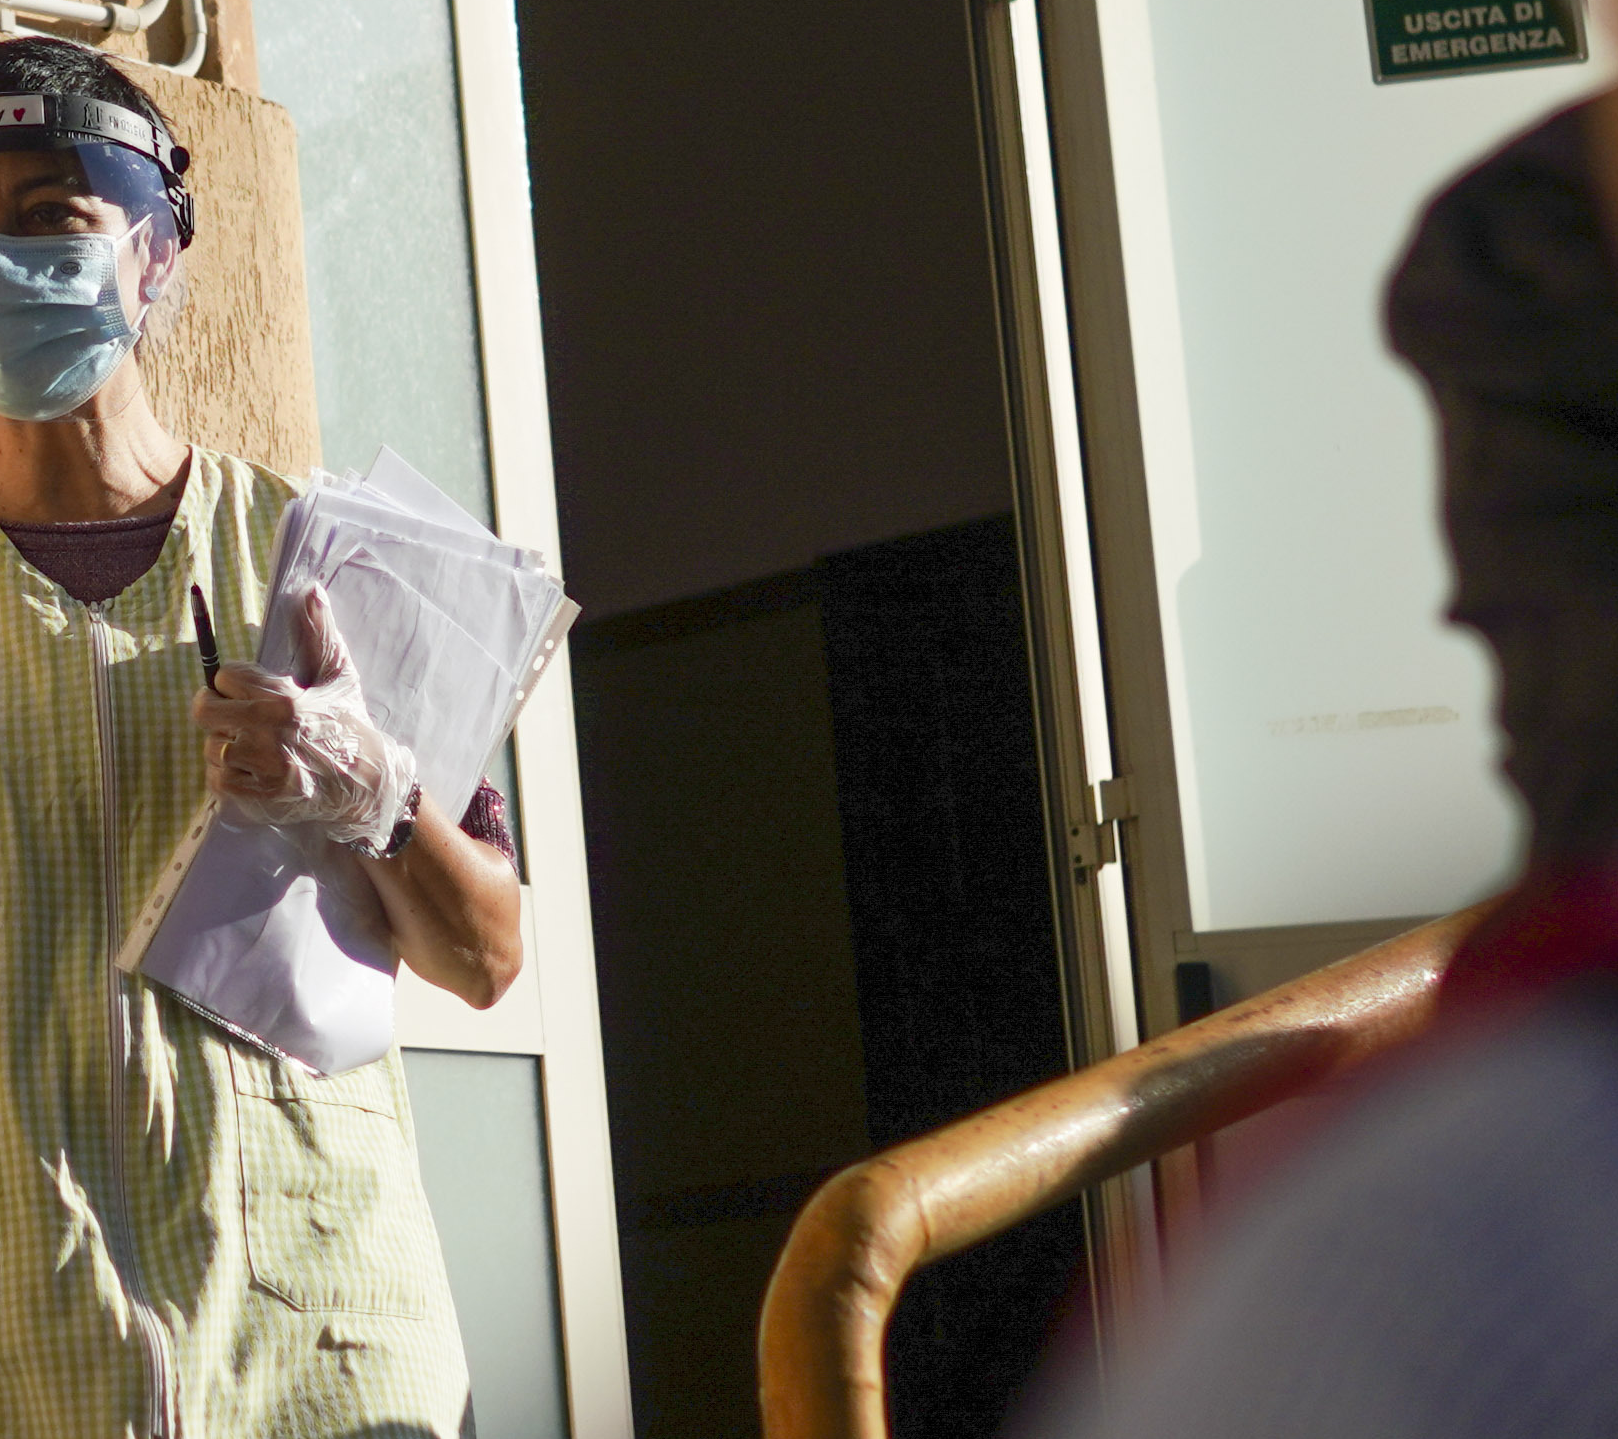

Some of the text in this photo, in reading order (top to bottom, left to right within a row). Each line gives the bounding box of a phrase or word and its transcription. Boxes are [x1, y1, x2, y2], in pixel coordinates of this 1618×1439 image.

[1405, 1, 1543, 33] USCITA DI
[1392, 28, 1564, 64] EMERGENZA
